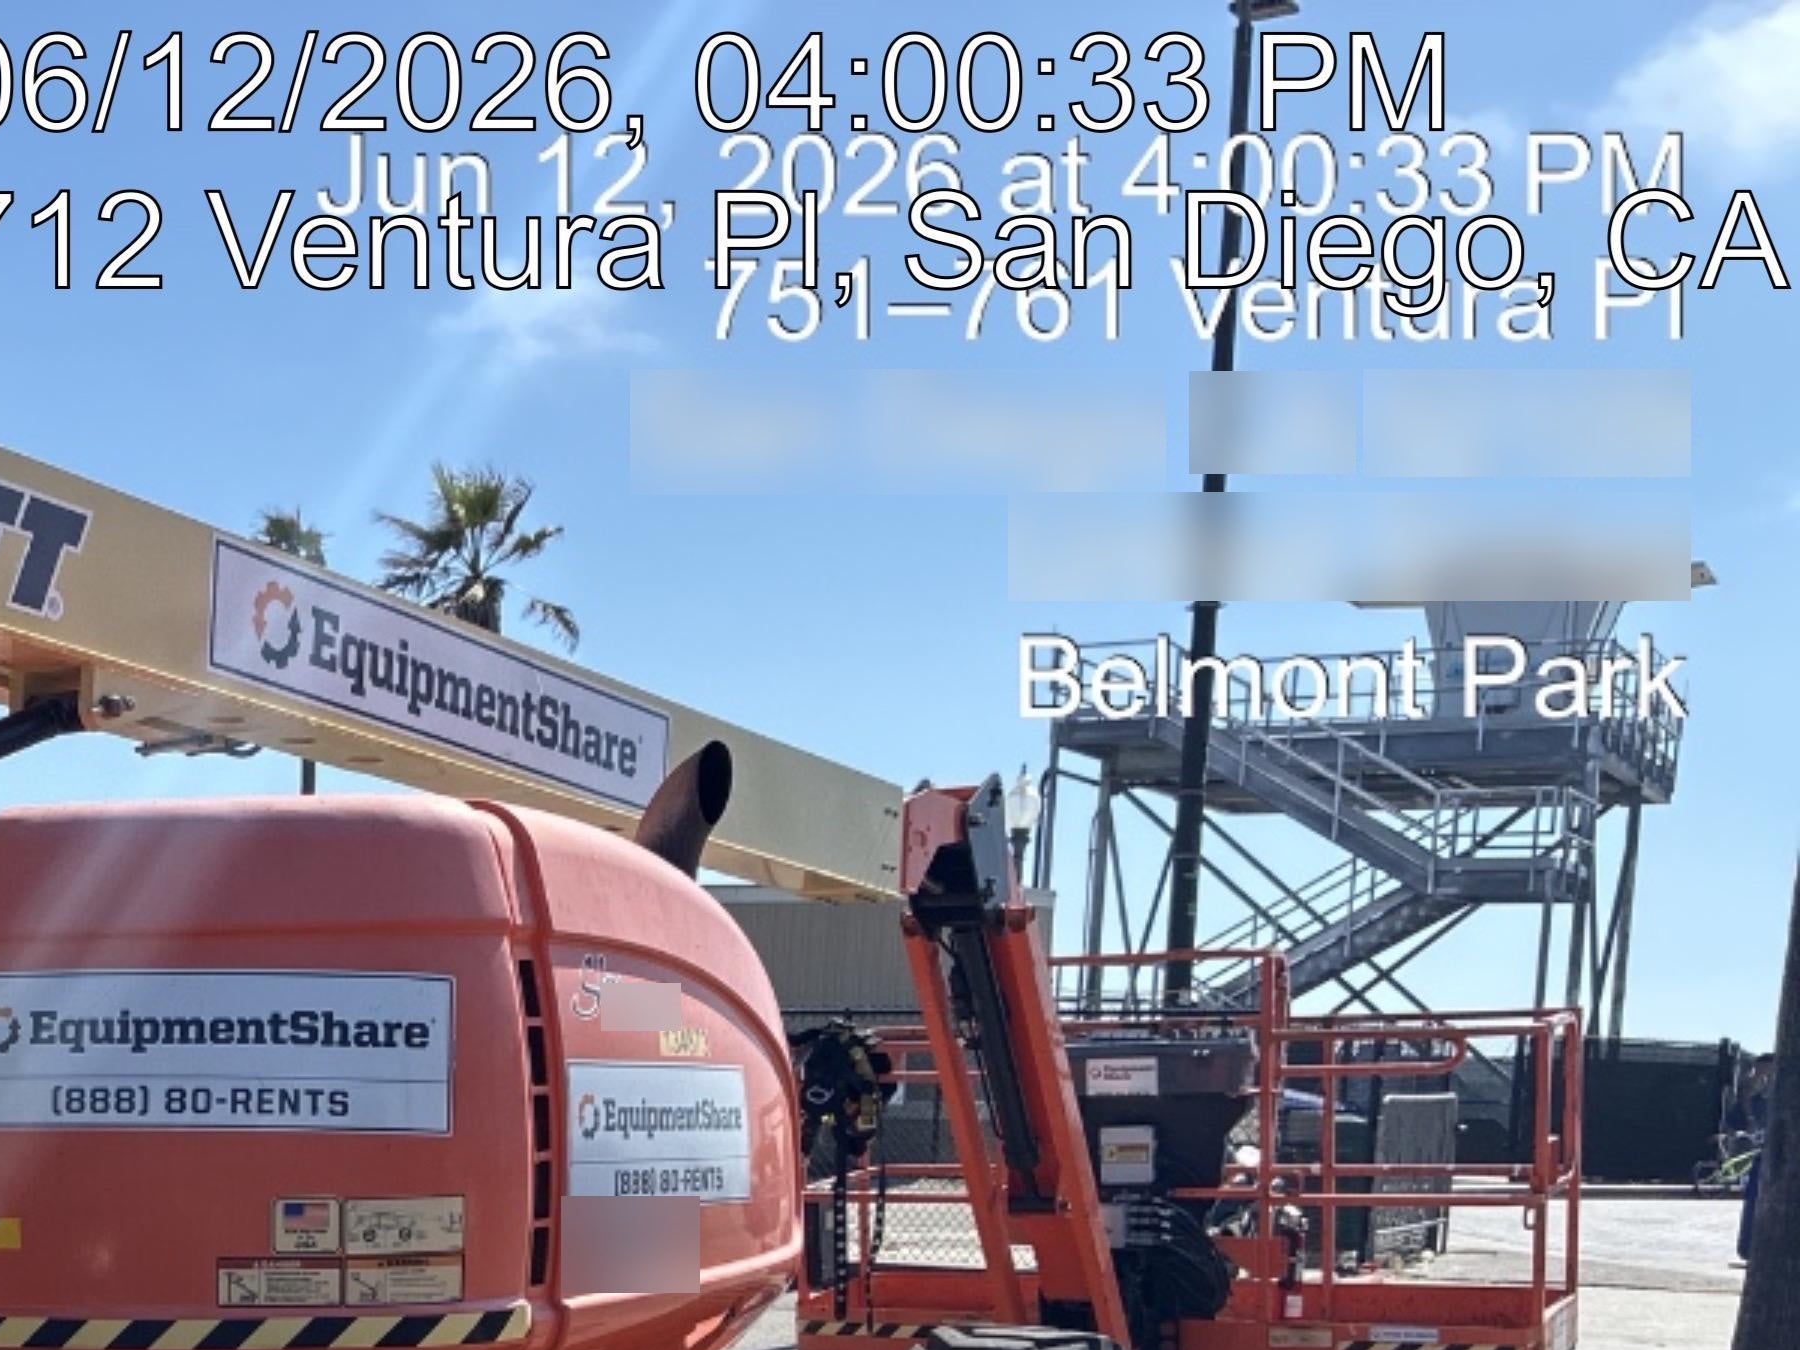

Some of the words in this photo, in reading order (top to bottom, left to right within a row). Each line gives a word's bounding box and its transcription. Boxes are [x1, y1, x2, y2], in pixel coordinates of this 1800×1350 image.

[308, 605, 638, 779] EquipmentShare
[29, 1009, 431, 1054] EquipmentShare
[51, 1085, 149, 1117] (888)
[164, 1087, 350, 1117] 80-RENTS
[602, 1097, 742, 1140] EquipmentShare
